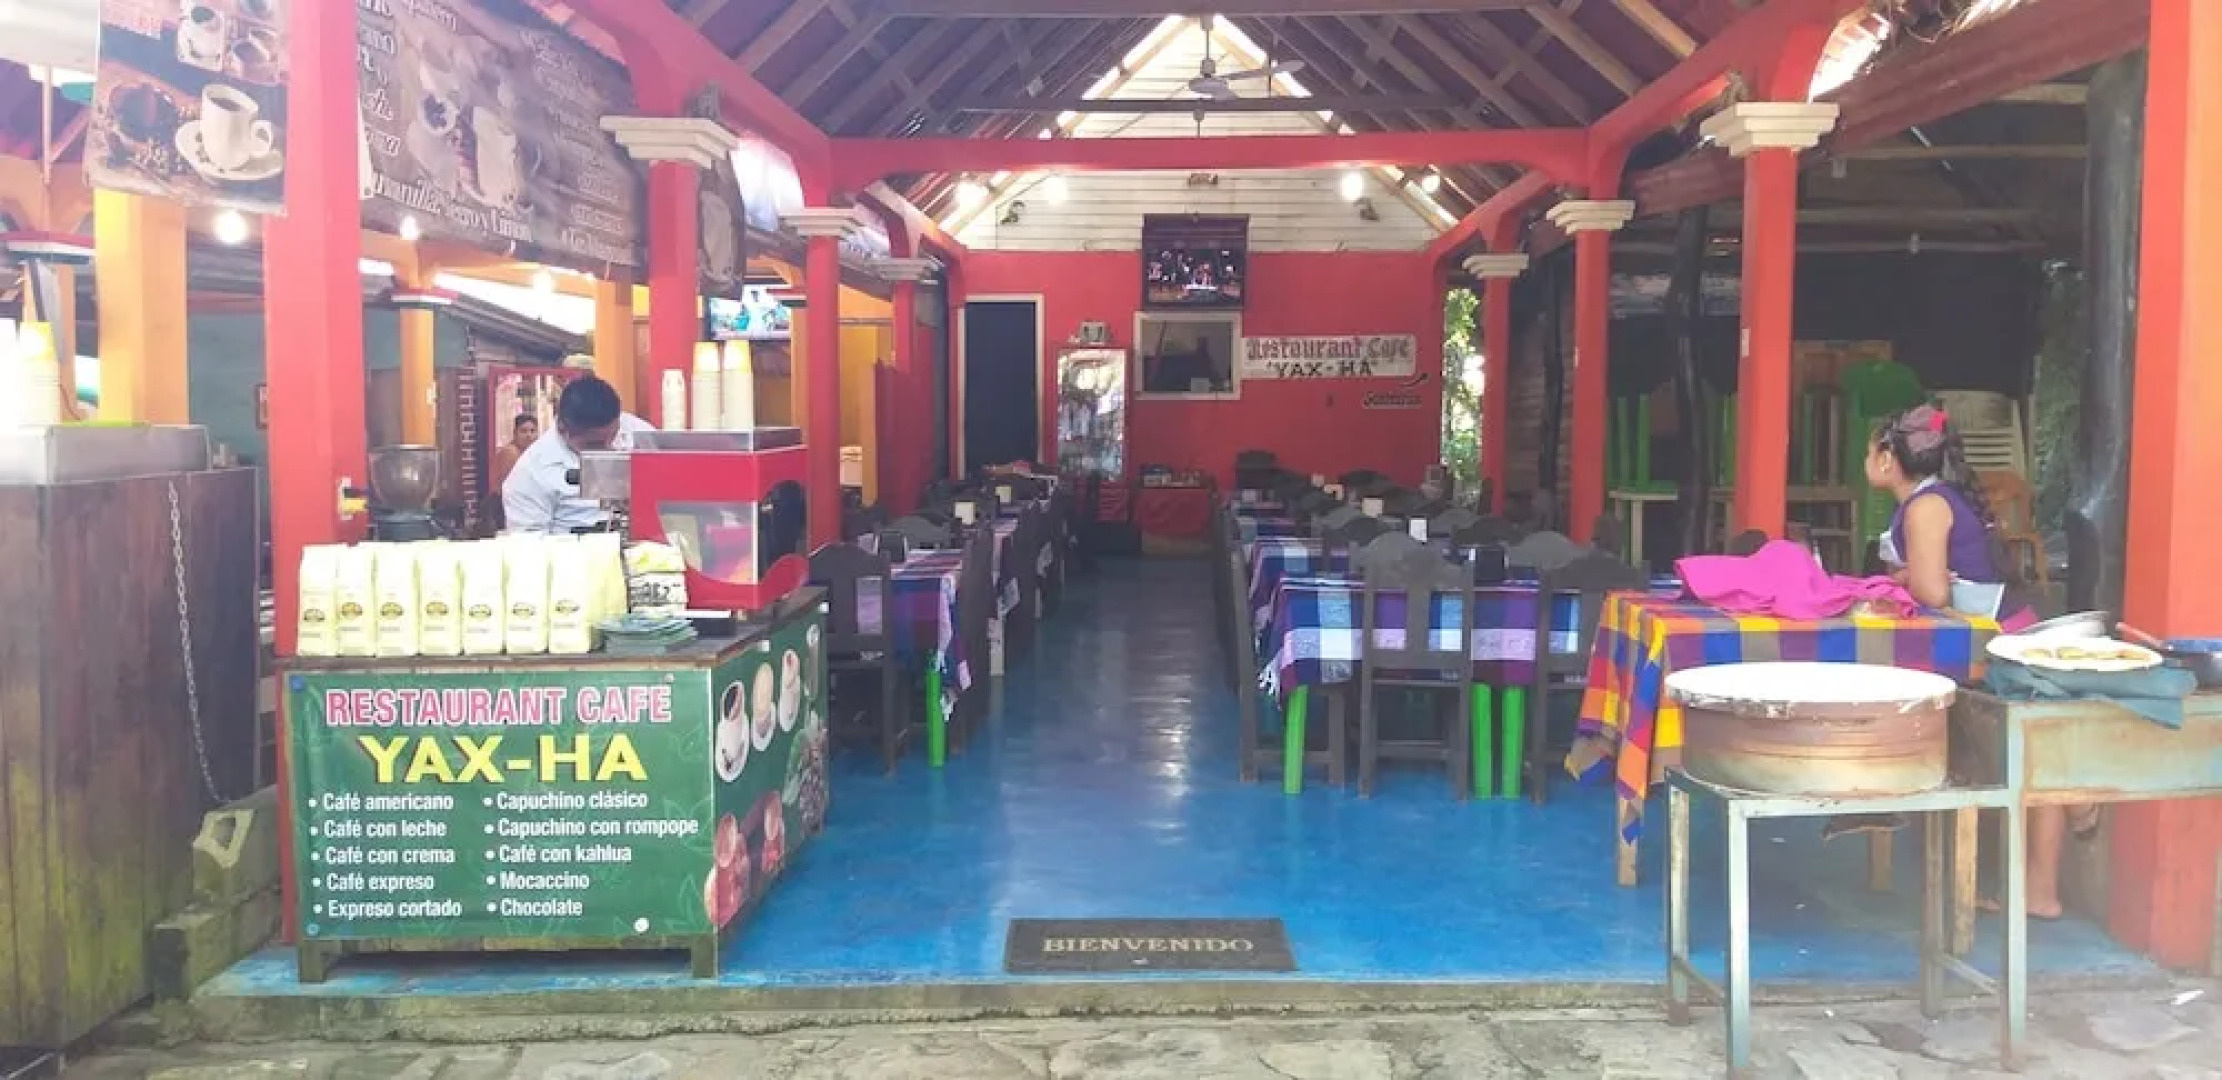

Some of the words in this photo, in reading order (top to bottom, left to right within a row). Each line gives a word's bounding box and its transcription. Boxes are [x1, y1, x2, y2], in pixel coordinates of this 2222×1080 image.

[1246, 336, 1363, 360] Restaurant
[326, 687, 567, 727] RESTAURANT
[577, 685, 671, 723] CAFE
[360, 733, 647, 782] YAX-HA
[323, 792, 361, 812] Café
[364, 792, 454, 810] americano
[497, 790, 585, 813] Capuchino
[588, 790, 648, 810] clásico
[323, 819, 363, 838] Café
[366, 823, 397, 838] con
[401, 819, 447, 837] leche
[497, 817, 586, 839] Capuchino
[590, 821, 621, 836] con
[624, 819, 699, 839] rompope
[325, 846, 363, 865] Café
[367, 850, 399, 864] con
[401, 848, 455, 863] crema
[499, 844, 537, 863] Café
[539, 848, 572, 863] con
[575, 844, 632, 863] kahlua
[326, 872, 365, 890] Café
[368, 875, 434, 894] expreso
[499, 870, 590, 890] Mocaccino
[328, 899, 394, 921] Expreso
[397, 899, 463, 917] cortado
[499, 897, 583, 916] Chocolate
[1043, 937, 1255, 952] BIENVENIDO
